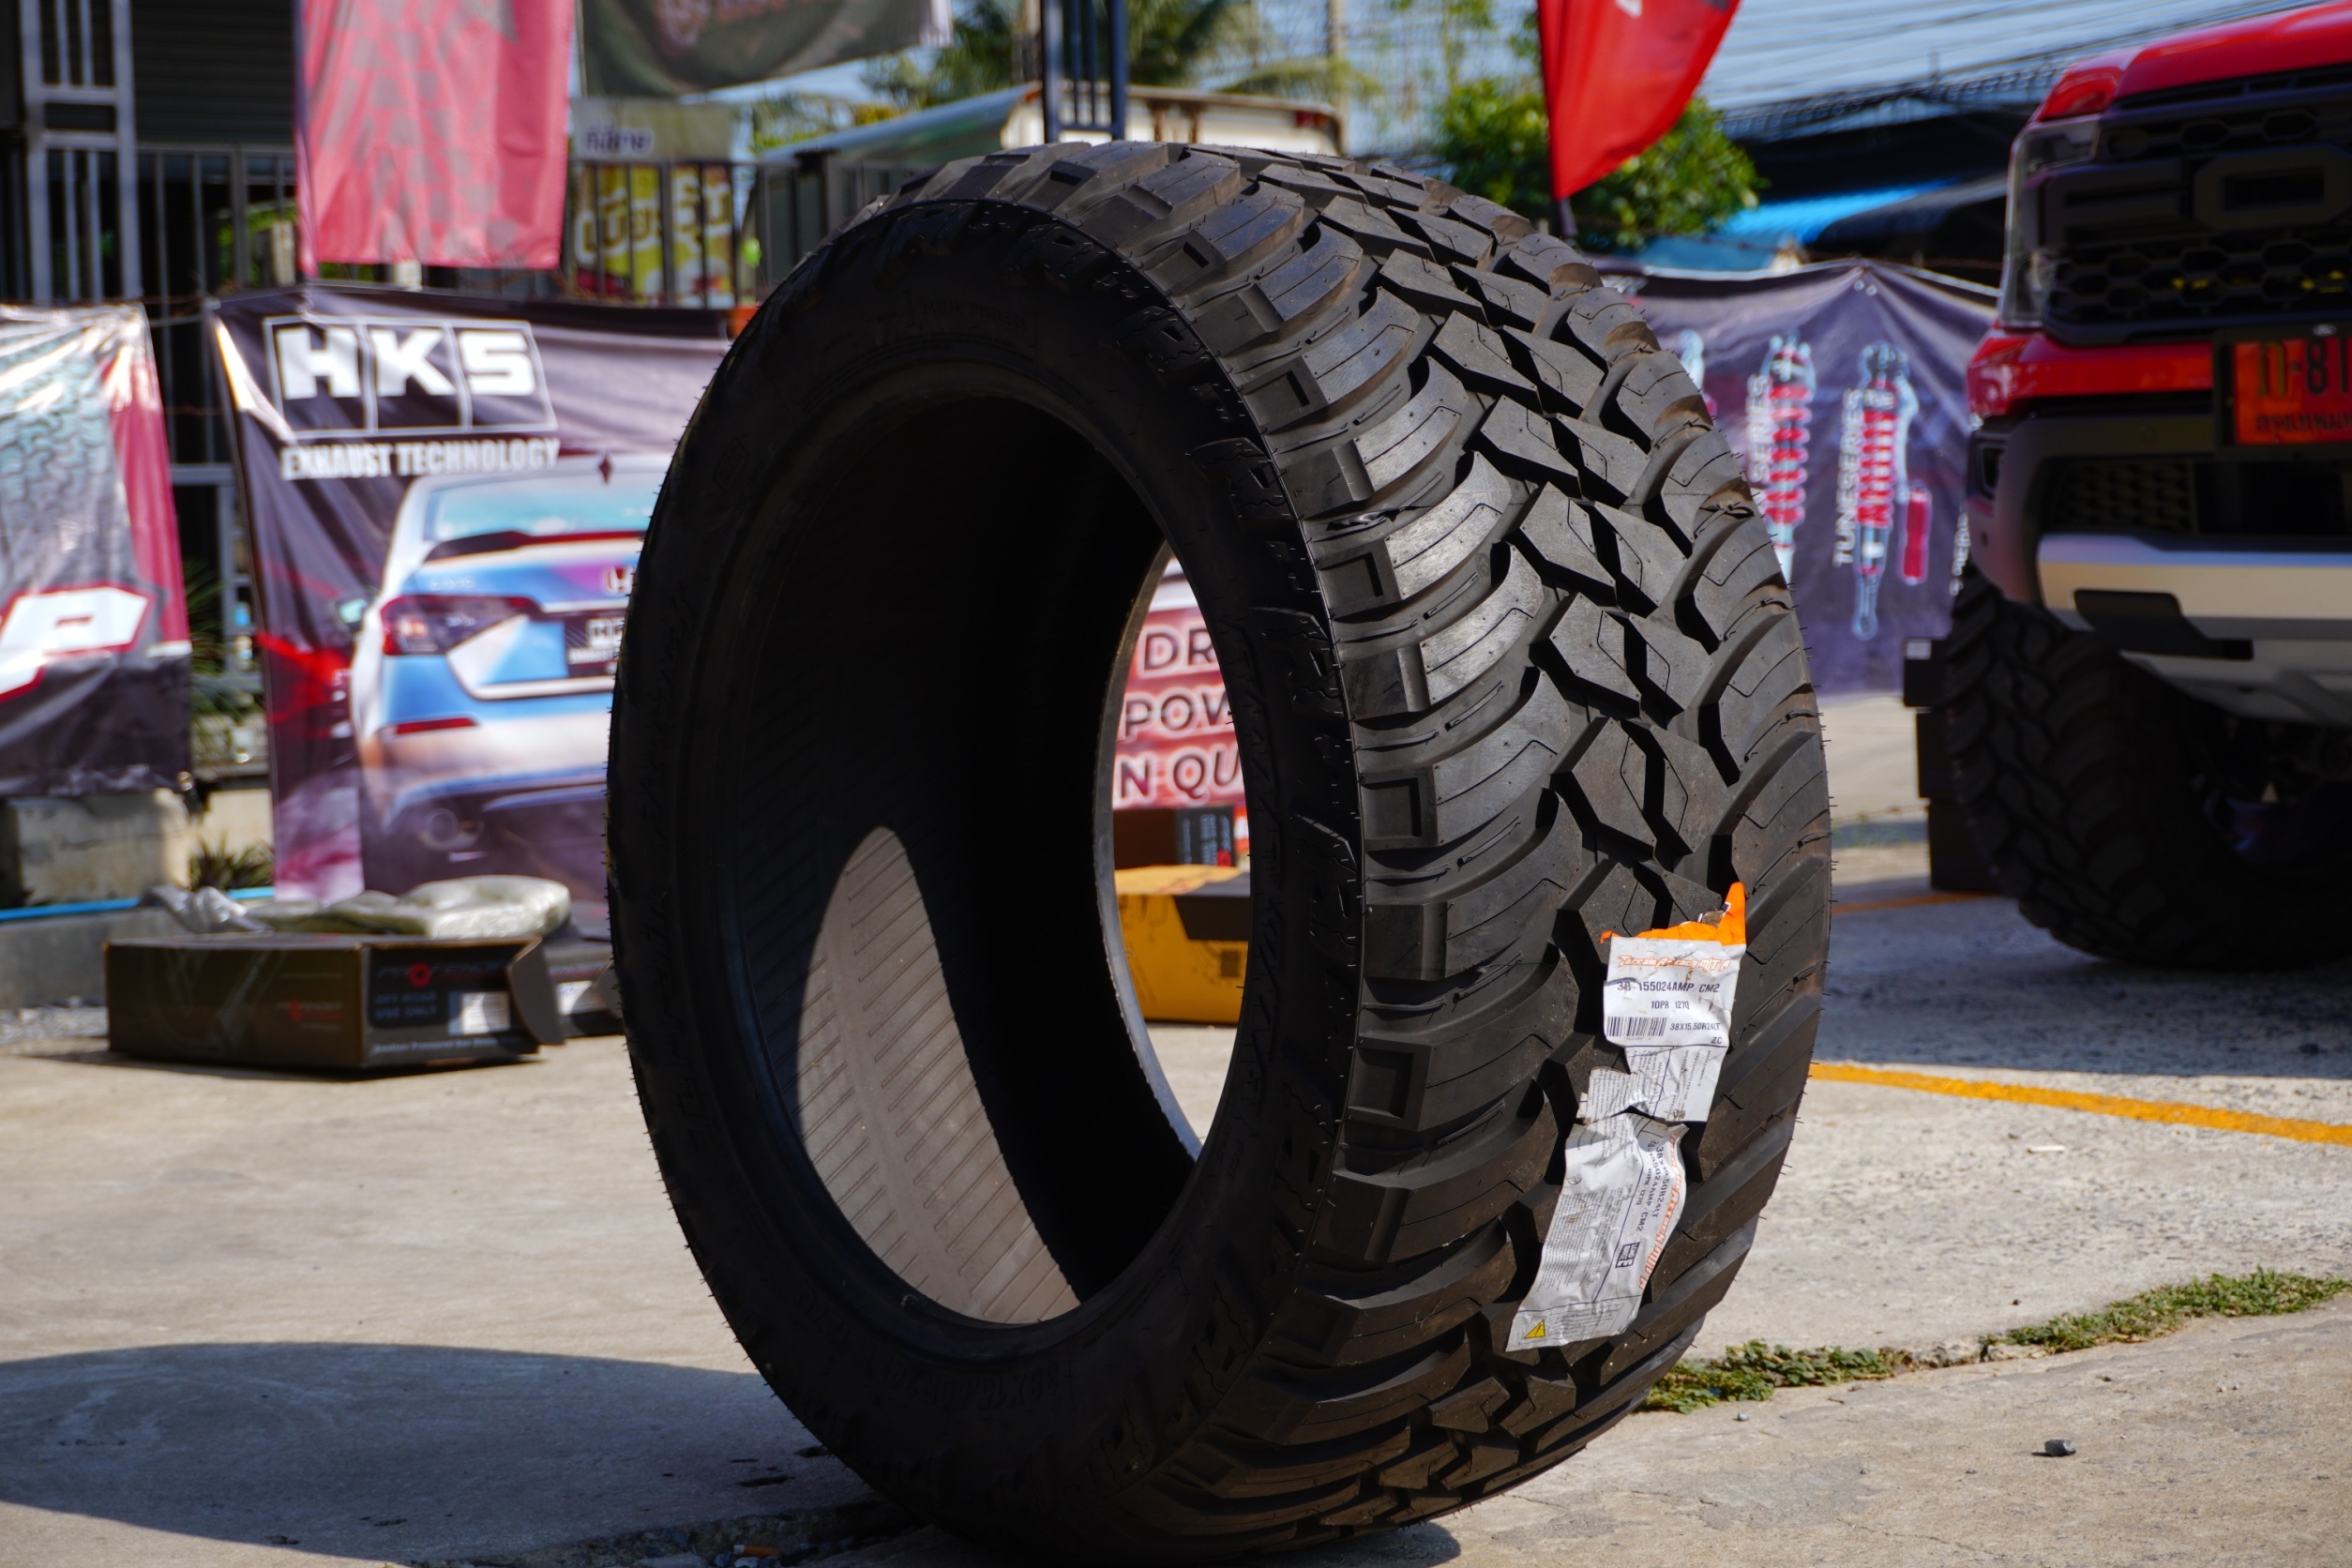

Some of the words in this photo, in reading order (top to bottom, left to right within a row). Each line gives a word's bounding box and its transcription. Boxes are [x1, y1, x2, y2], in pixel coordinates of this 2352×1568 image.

[275, 325, 536, 400] HKS
[1745, 373, 1773, 483] SERIES
[280, 443, 392, 480] EXHAUST
[395, 437, 562, 475] TECHNOLOGY
[1833, 387, 1864, 567] TUNESERIES
[1651, 1000, 1669, 1010] 10PR
[1711, 1036, 1723, 1045] ZC
